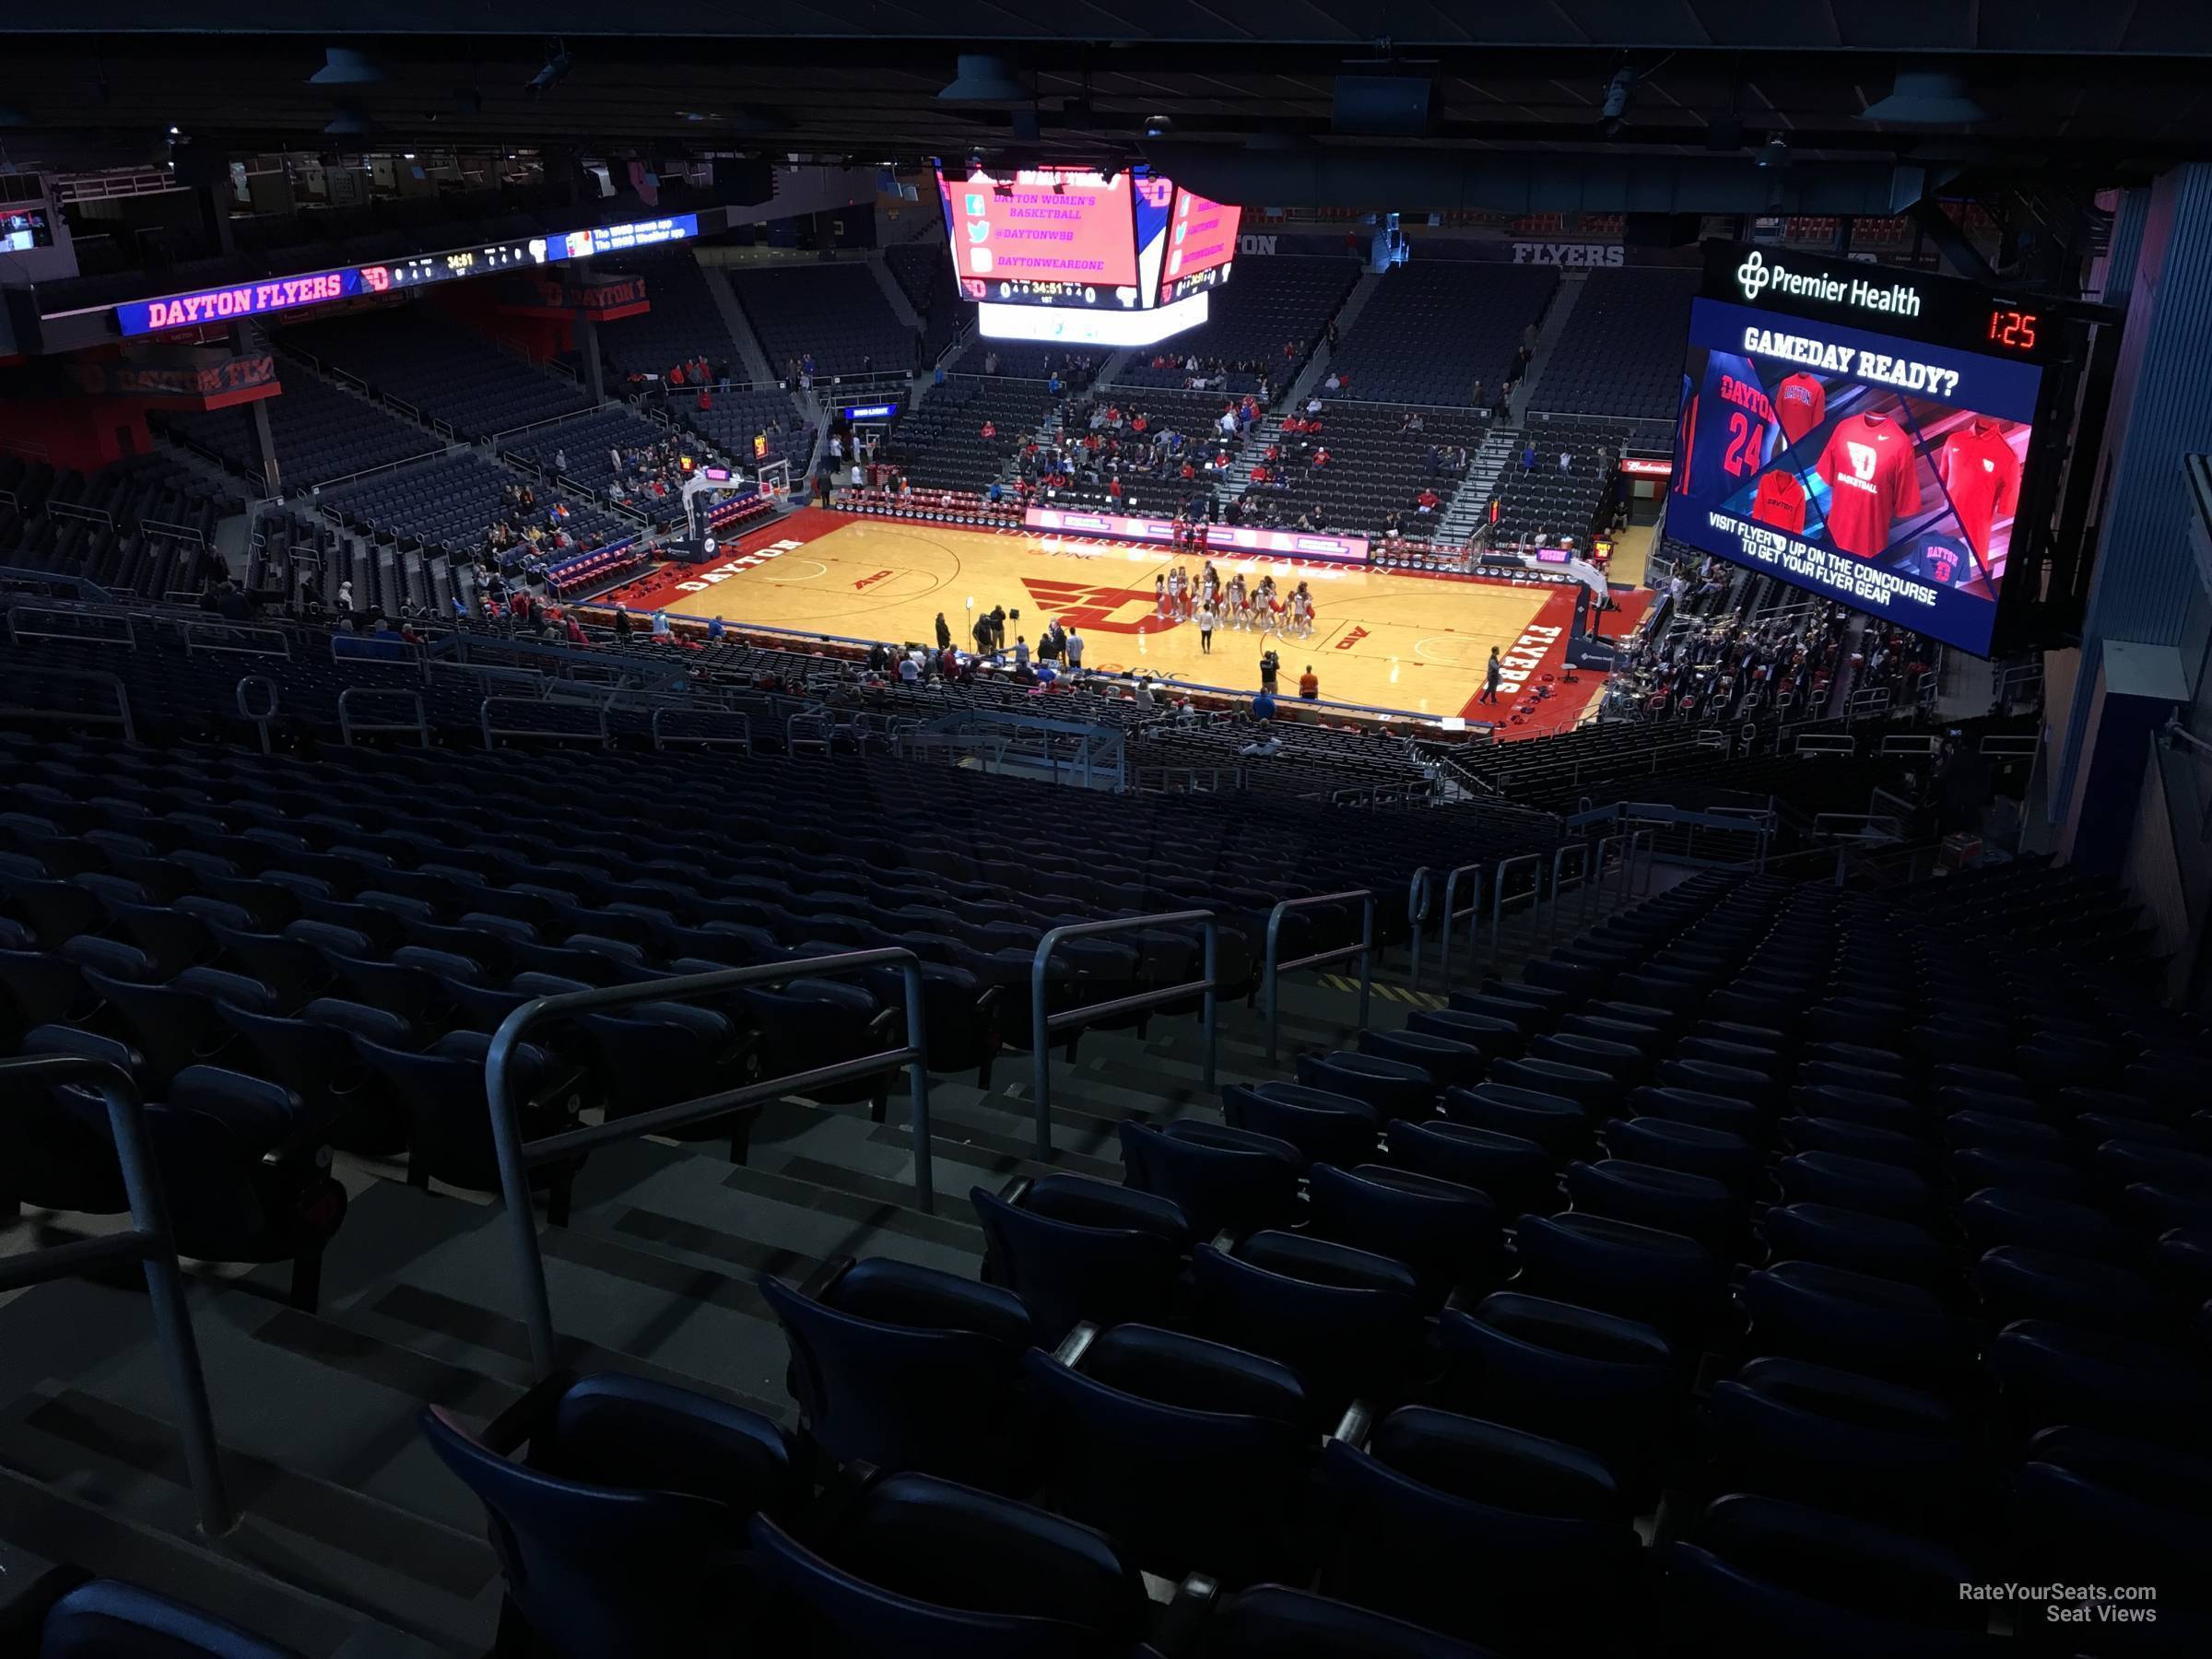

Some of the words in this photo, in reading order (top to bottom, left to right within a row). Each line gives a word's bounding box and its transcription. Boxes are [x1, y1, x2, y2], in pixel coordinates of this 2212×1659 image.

[1010, 208, 1082, 219] BASKETBALL
[1041, 194, 1096, 206] WOMEN'S
[998, 256, 1104, 270] DAYTONWEAREONE
[1512, 243, 1624, 267] FLYERS
[148, 288, 252, 328] DAYTON
[257, 275, 341, 310] FLYERS
[1032, 282, 1062, 294] 34:51
[1772, 265, 1847, 302] Premier
[1851, 279, 1921, 317] Health
[1991, 312, 2036, 347] 1:25
[1745, 326, 1855, 372] GAMEDAY
[1857, 350, 1959, 397] READY?
[1724, 412, 1764, 477] 24
[1838, 472, 1877, 494] BASKETBALL
[675, 539, 805, 592] DAYTON
[995, 528, 1165, 552] UNIVERSIT
[1244, 555, 1395, 575] DAYTON
[1710, 512, 1737, 533] VISIT
[1789, 540, 1806, 558] UP
[1807, 547, 1826, 565] ON
[1828, 553, 1853, 575] THE
[1853, 564, 1937, 606] CONCOURSE
[1742, 538, 1757, 555] TO
[1759, 546, 1782, 564] GET
[1783, 553, 1815, 577] YOUR
[1816, 566, 1853, 593] FLYER
[1855, 580, 1890, 606] GEAR
[1130, 666, 1190, 680] PNC
[1483, 624, 1563, 694] FLYERS
